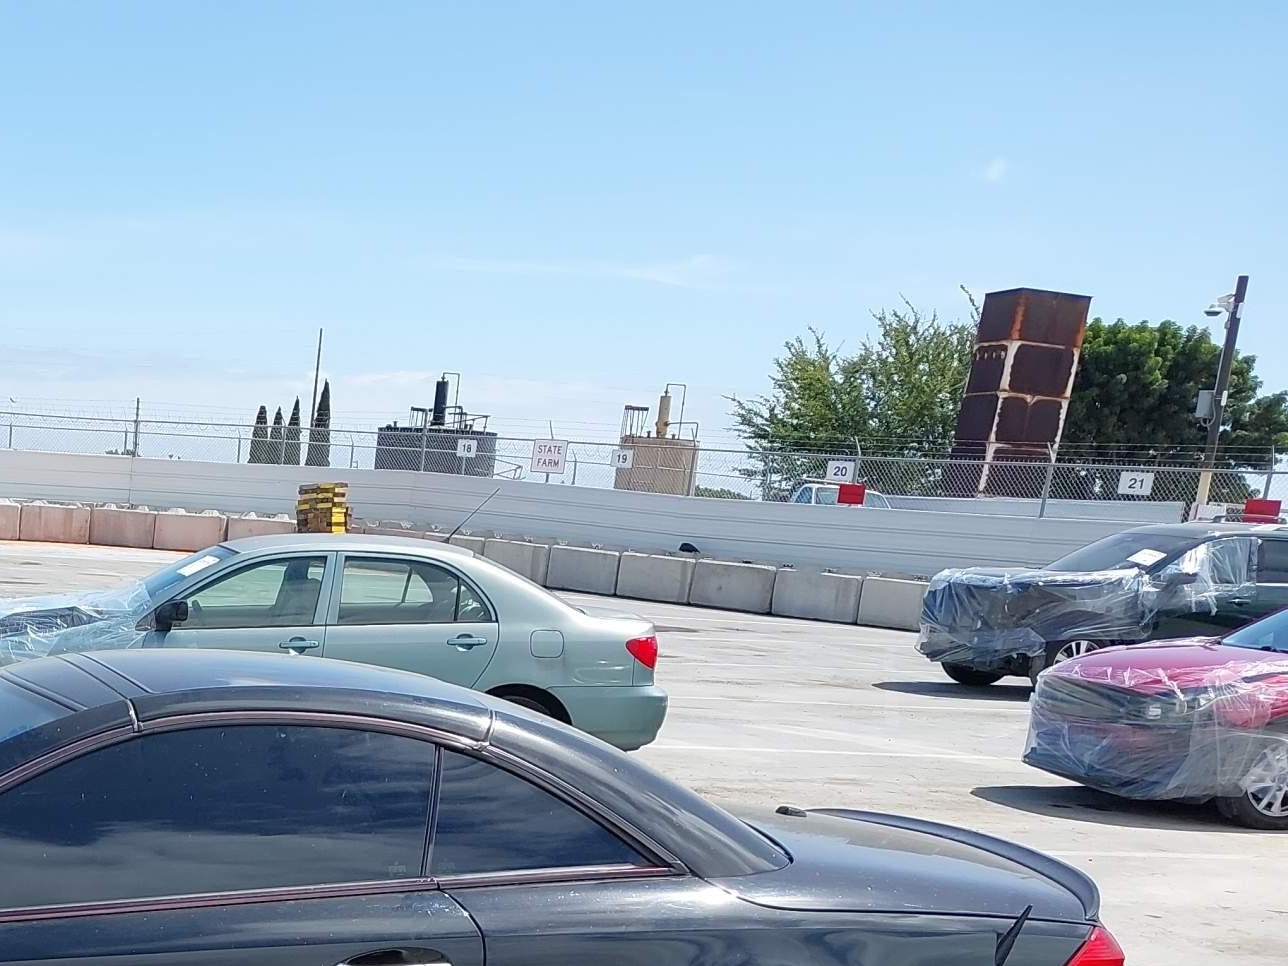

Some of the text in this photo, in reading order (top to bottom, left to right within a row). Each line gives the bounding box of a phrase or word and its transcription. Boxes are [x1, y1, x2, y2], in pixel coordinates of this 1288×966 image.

[462, 443, 472, 453] 18
[537, 444, 563, 455] STATE
[536, 457, 560, 468] FARM
[616, 453, 627, 464] 19
[833, 466, 848, 477] 20
[1127, 477, 1145, 489] 21
